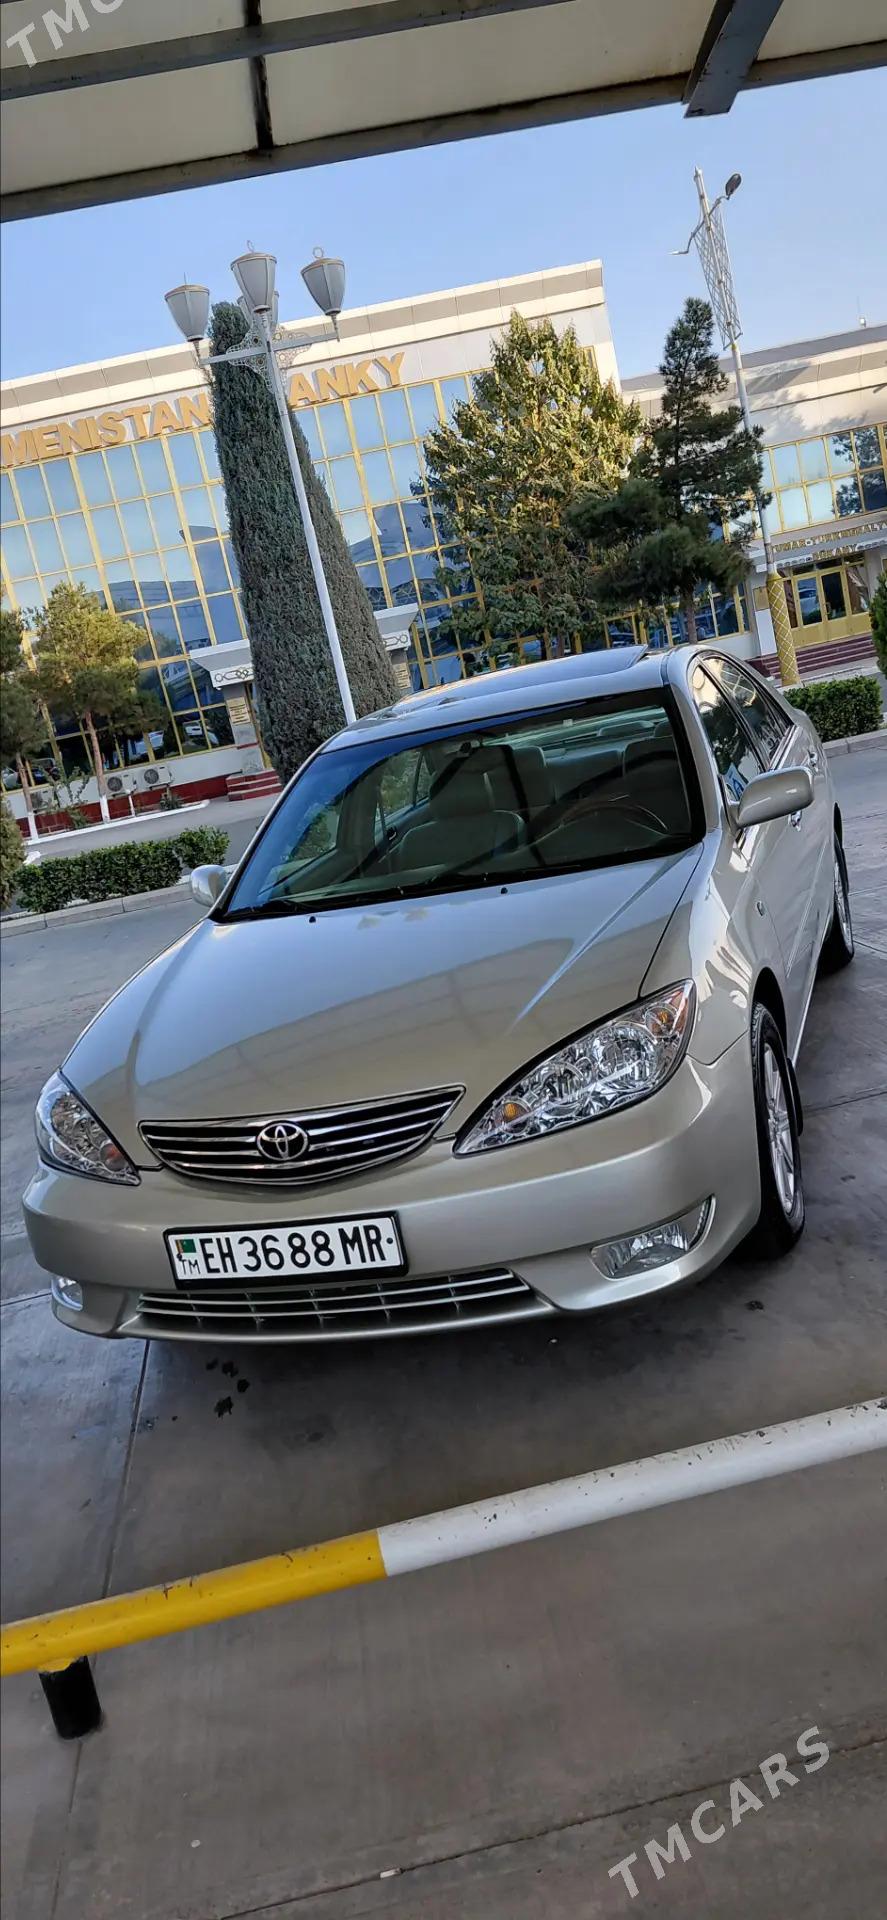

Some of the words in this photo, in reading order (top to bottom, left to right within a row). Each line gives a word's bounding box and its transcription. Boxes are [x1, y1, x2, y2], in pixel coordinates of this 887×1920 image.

[288, 352, 405, 406] ANKY
[180, 1259, 200, 1275] TM
[199, 1237, 238, 1274] EH
[238, 1230, 335, 1272] 3688
[338, 1224, 386, 1265] MR
